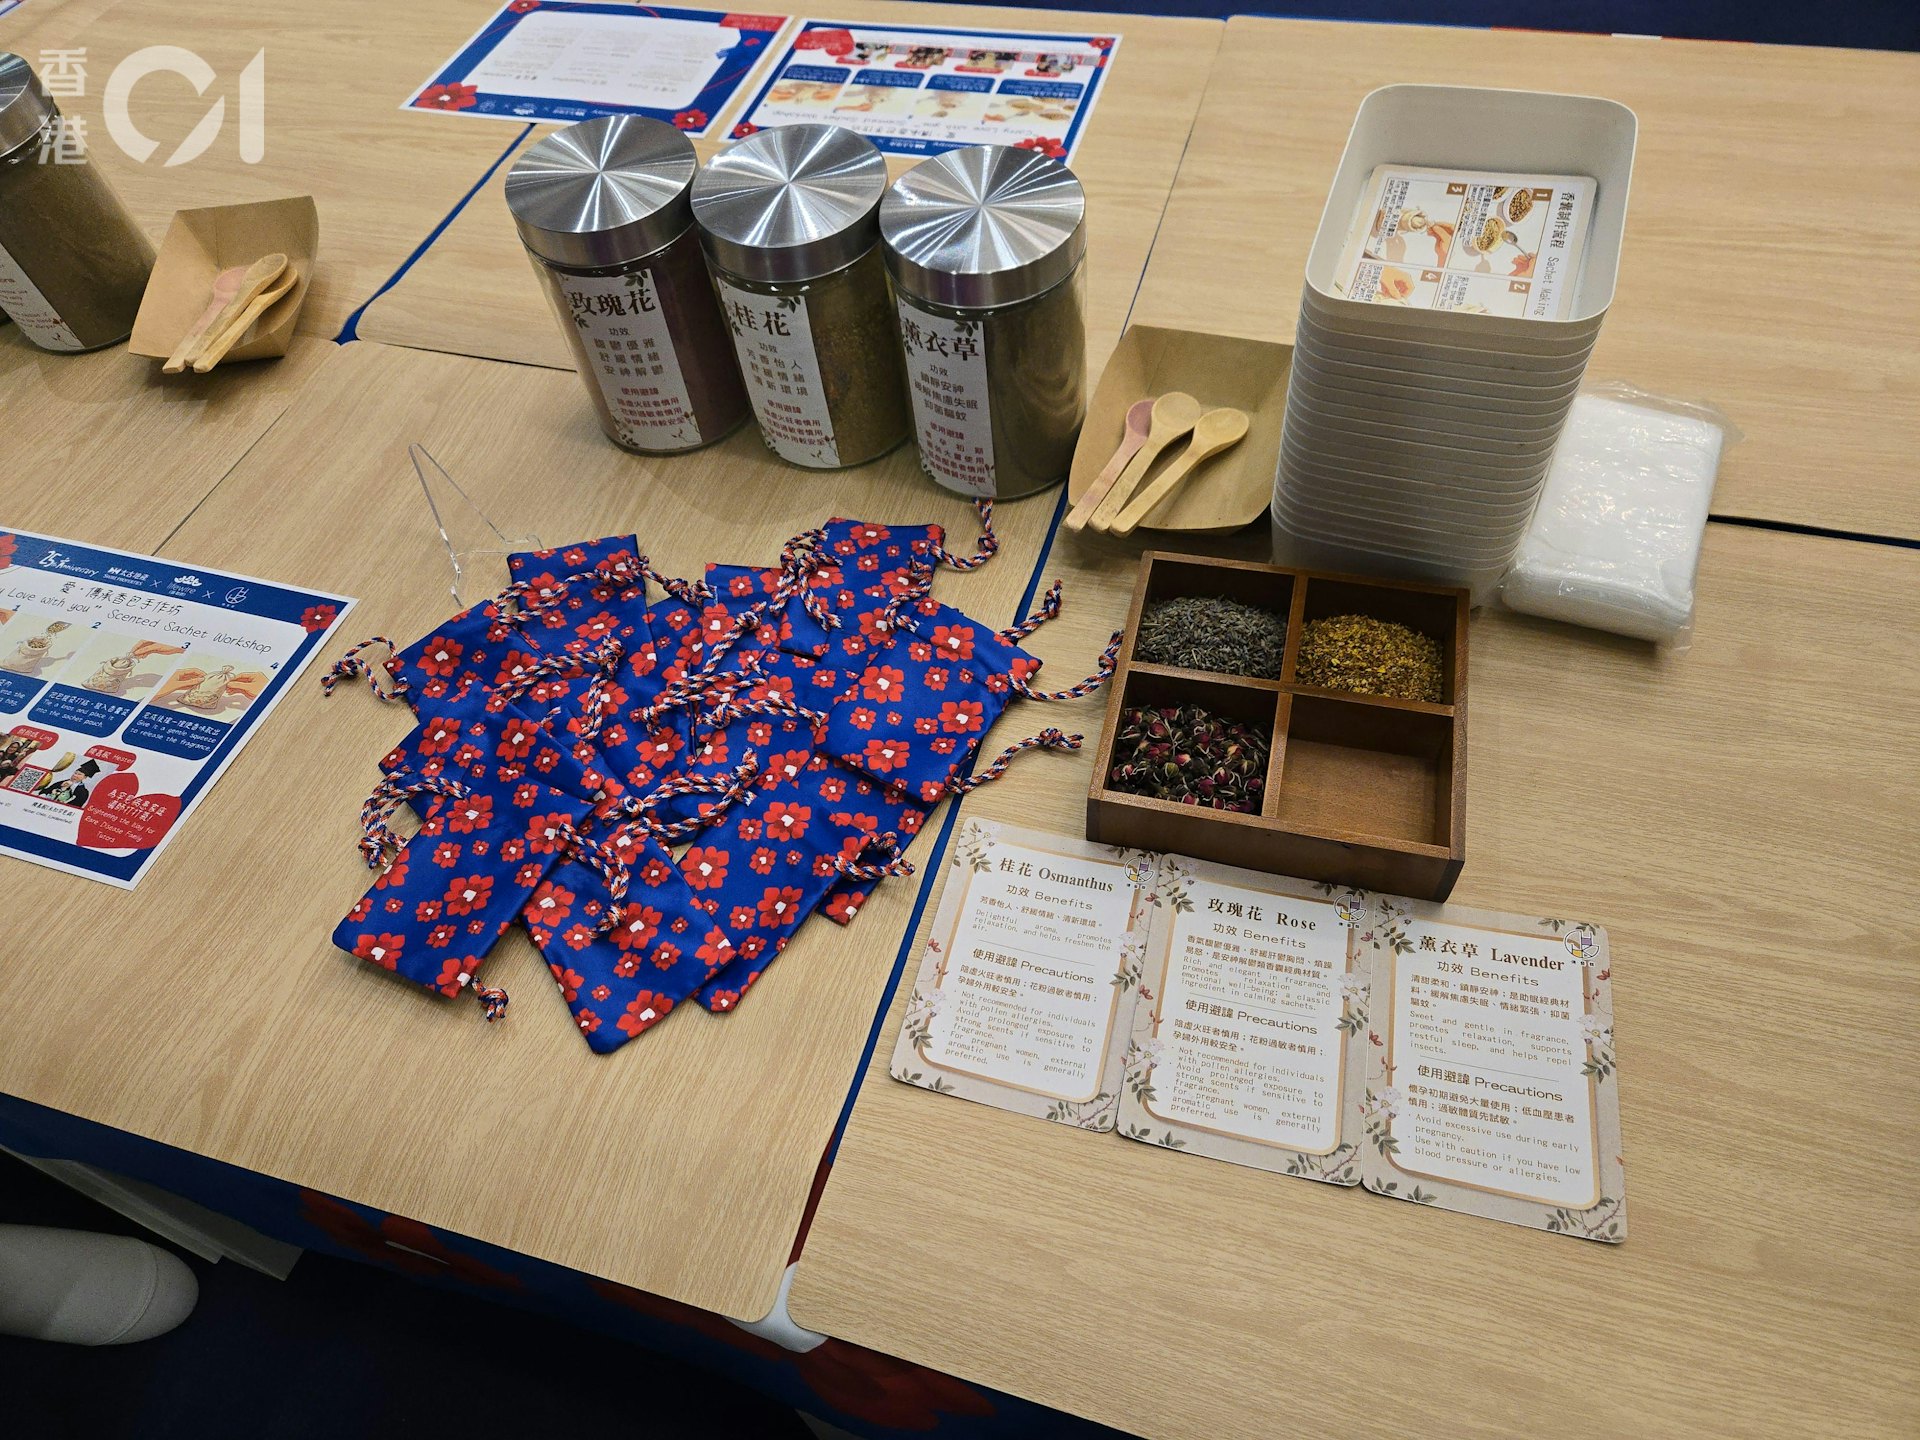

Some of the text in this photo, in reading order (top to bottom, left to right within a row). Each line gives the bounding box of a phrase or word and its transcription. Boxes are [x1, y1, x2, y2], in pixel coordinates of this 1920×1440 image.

[1451, 185, 1463, 193] 3
[1426, 272, 1437, 281] 4
[1533, 257, 1560, 317] Sachet Making
[568, 289, 656, 316] 玫瑰花
[734, 302, 790, 336] 桂花
[759, 342, 778, 353] 功效
[904, 318, 979, 361] 薰衣草
[930, 365, 948, 376] 功效
[8, 588, 35, 600] Love
[41, 597, 65, 607] with
[108, 609, 159, 628] Scented
[164, 621, 208, 639] Sachet
[213, 633, 272, 654] Workshop
[91, 622, 101, 630] 2
[140, 731, 163, 739] release
[190, 734, 217, 743] squeeze
[112, 754, 134, 763] Hester
[87, 805, 118, 822] Brightening
[86, 816, 99, 825] Rare
[100, 822, 123, 834] Disease
[125, 831, 142, 842] Family
[98, 831, 115, 843] Tutors
[999, 857, 1114, 893] 桂花 Osmanthus
[1006, 884, 1093, 910] 功效 Benefits
[972, 924, 987, 932] air.
[976, 909, 1018, 924] Delightful
[1077, 932, 1112, 944] promotes
[1208, 898, 1317, 931] 玫瑰花 Rose
[1024, 928, 1037, 938] and
[1040, 931, 1060, 942] helps
[1065, 938, 1094, 948] freshen
[1212, 922, 1306, 949] 功效 Benefits
[973, 948, 1094, 984] 使用避諱 Precautions
[1419, 936, 1565, 971] 薰衣草 Lavender
[1437, 960, 1539, 987] 功效 Benefits
[959, 1000, 1053, 1028] with pollen allergies.
[962, 991, 1096, 1028] Not recommended for individuals
[1185, 999, 1318, 1035] 使用避諱 Precautions
[953, 1023, 994, 1040] fragrance.
[956, 1015, 982, 1028] strong
[988, 1024, 1014, 1036] scents
[1035, 1035, 1075, 1049] sensitive
[957, 1007, 979, 1018] Avoid
[988, 1015, 1029, 1030] prolonged
[1038, 1027, 1074, 1041] exposure
[1410, 1011, 1434, 1022] Sweet
[1442, 1017, 1457, 1026] and
[1464, 1021, 1495, 1032] gentle
[1504, 1028, 1512, 1036] in
[951, 1031, 963, 1039] For
[971, 1037, 1007, 1051] pregnant
[1051, 1057, 1087, 1070] external
[1409, 1021, 1449, 1034] promotes
[1531, 1043, 1572, 1056] supports
[1410, 1042, 1447, 1054] insects.
[1410, 1031, 1443, 1043] restful
[1490, 1047, 1505, 1055] and
[1512, 1049, 1538, 1061] helps
[1547, 1056, 1572, 1066] repel
[945, 1049, 988, 1065] preferred.
[948, 1041, 984, 1054] aromatic
[996, 1052, 1009, 1061] use
[1044, 1065, 1085, 1079] generally
[1417, 1064, 1563, 1102] 使用避諱 Precautions
[1415, 1125, 1464, 1142] pregnancy.
[1416, 1114, 1579, 1152] Avoid excessive use during early
[1415, 1135, 1581, 1175] Use with caution if you have low
[1415, 1147, 1562, 1184] blood pressure or allergies.
